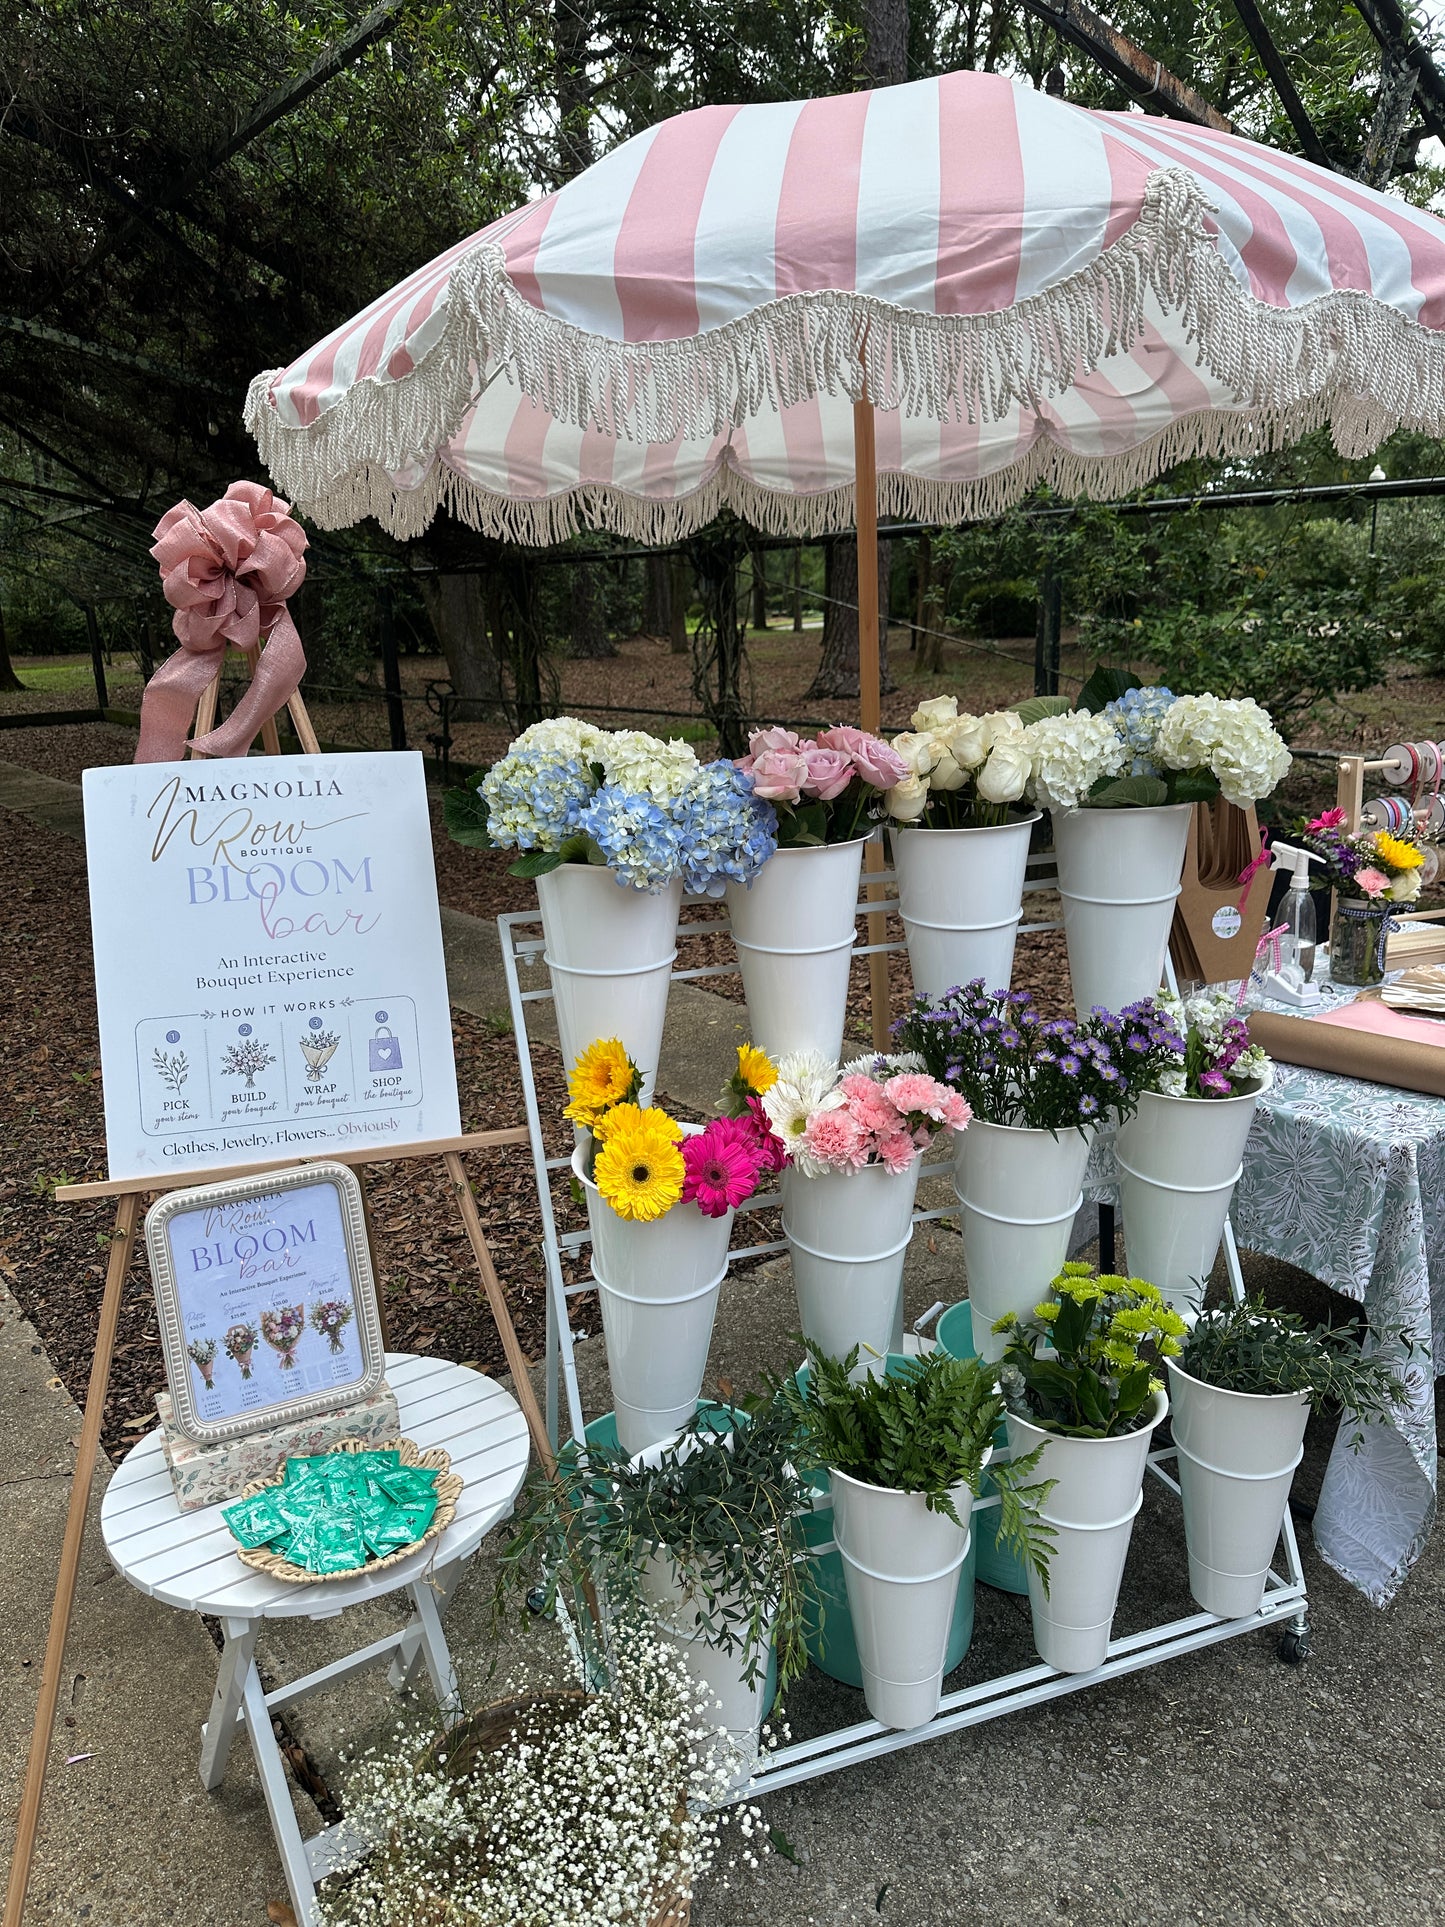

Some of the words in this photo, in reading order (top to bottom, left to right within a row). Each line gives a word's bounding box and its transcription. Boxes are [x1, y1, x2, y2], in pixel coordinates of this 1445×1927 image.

[185, 779, 344, 803] MAGNOLIA
[240, 845, 313, 858] BOUTIQUE
[185, 856, 374, 905] BLOOM
[259, 881, 382, 940] bar
[217, 957, 239, 970] An
[243, 950, 327, 968] Interactive
[196, 973, 263, 990] Bouquet
[267, 965, 355, 985] Experience
[220, 1006, 256, 1019] HOW
[263, 1005, 276, 1015] IT
[284, 999, 336, 1013] WORKS
[303, 1083, 337, 1095] WRAP
[372, 1076, 402, 1088] SHOP
[231, 1091, 266, 1104] BUILD
[294, 1099, 316, 1113] your
[317, 1093, 350, 1108] bouquet
[363, 1089, 378, 1100] the
[379, 1087, 413, 1101] boutique
[163, 1099, 190, 1111] PICK
[221, 1107, 244, 1122] your
[246, 1101, 279, 1116] bouquet
[154, 1114, 176, 1129] your
[178, 1112, 200, 1122] stems
[162, 1141, 219, 1157] Clothes,
[220, 1133, 274, 1152] Jewelry,
[276, 1127, 336, 1144] Flowers...
[337, 1117, 401, 1137] Obviously
[216, 1192, 284, 1213] MAGNOLIA
[239, 1219, 271, 1230] BOUTIQUE
[190, 1219, 317, 1273] BLOOM
[239, 1248, 302, 1280] bar
[229, 1284, 256, 1295] Interactive
[257, 1278, 279, 1289] Bouquet
[279, 1271, 307, 1282] Experience
